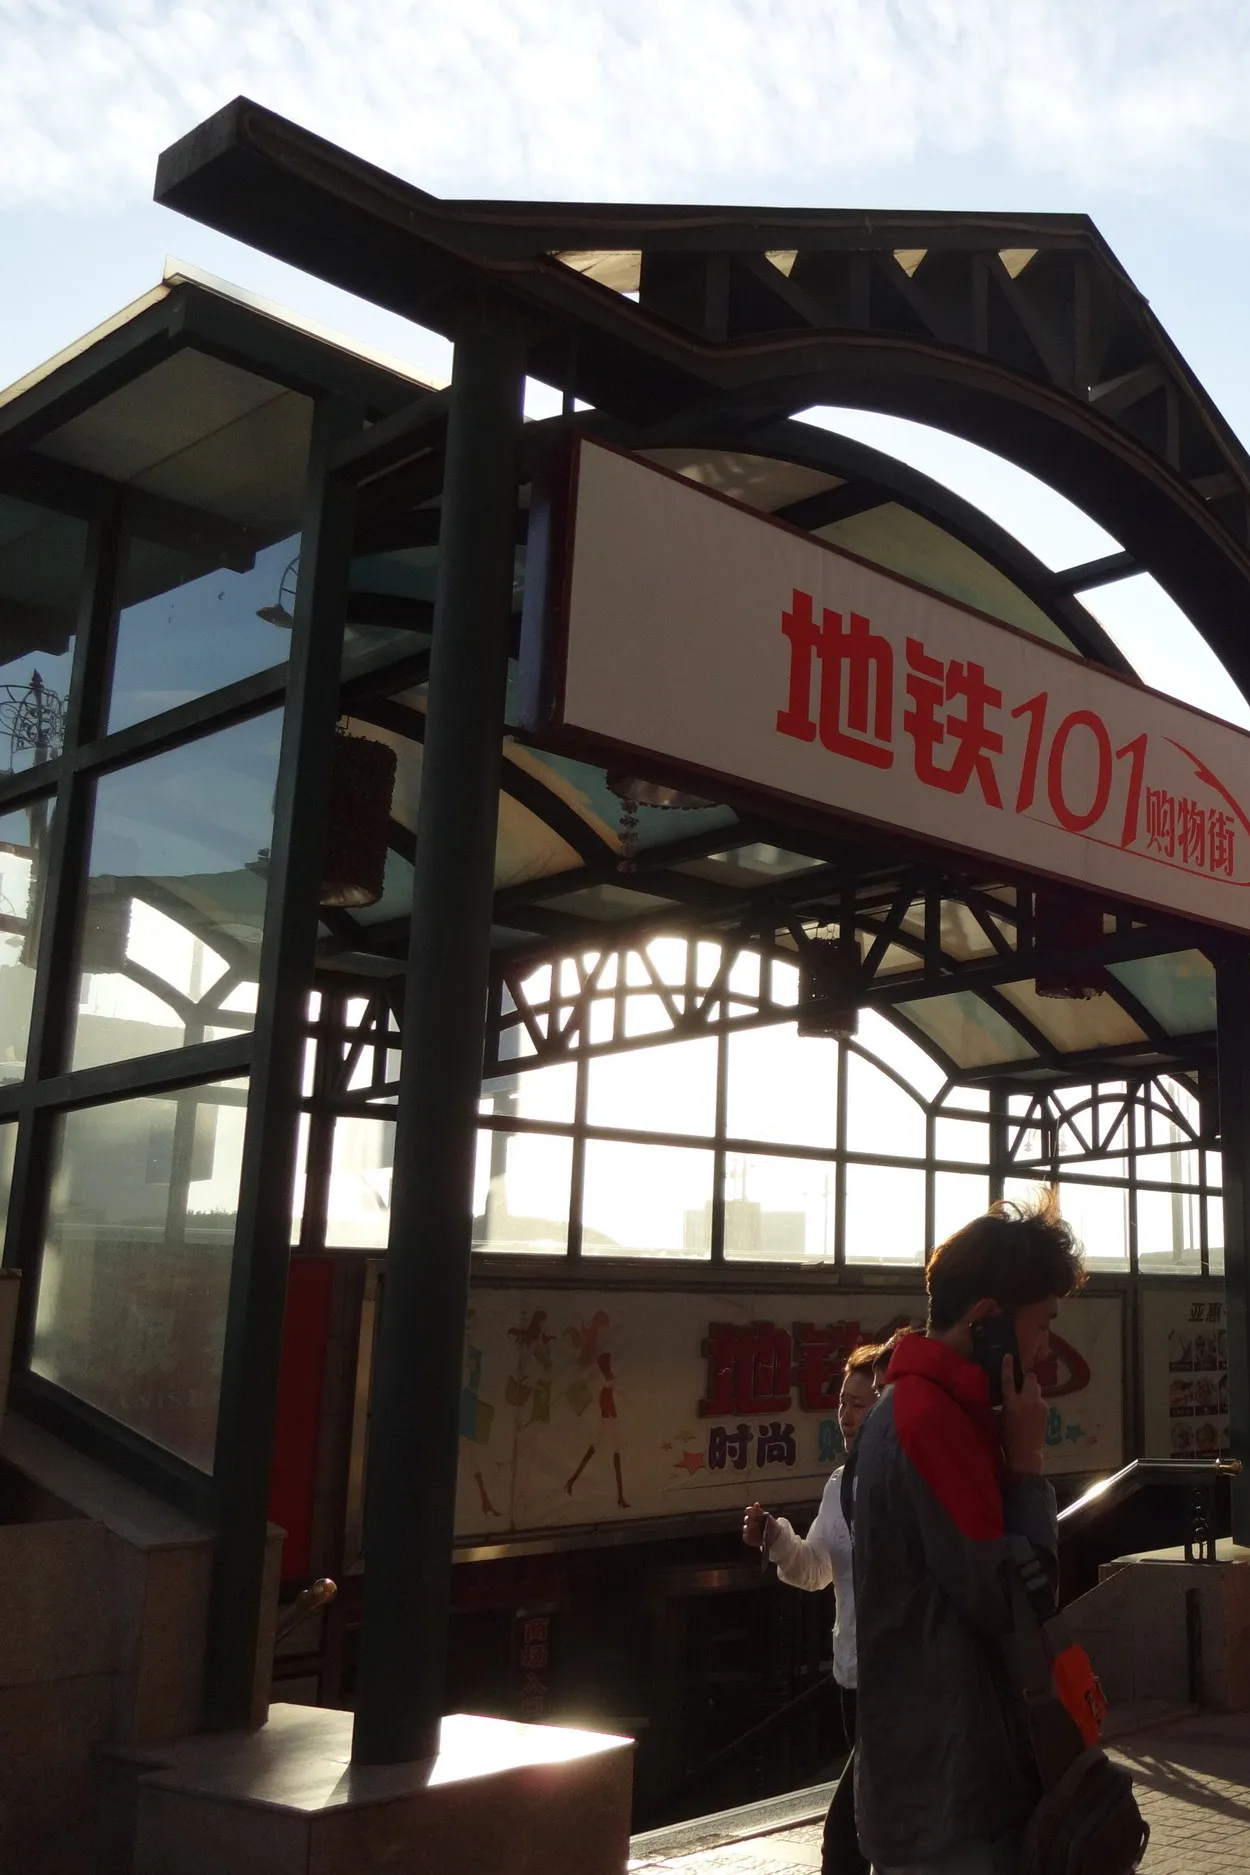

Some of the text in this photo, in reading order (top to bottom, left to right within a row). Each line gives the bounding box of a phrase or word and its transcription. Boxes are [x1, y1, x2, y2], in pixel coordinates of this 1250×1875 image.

[776, 588, 1148, 849] 地铁101
[1145, 788, 1236, 877] 购物街
[708, 1421, 797, 1471] 时尚
